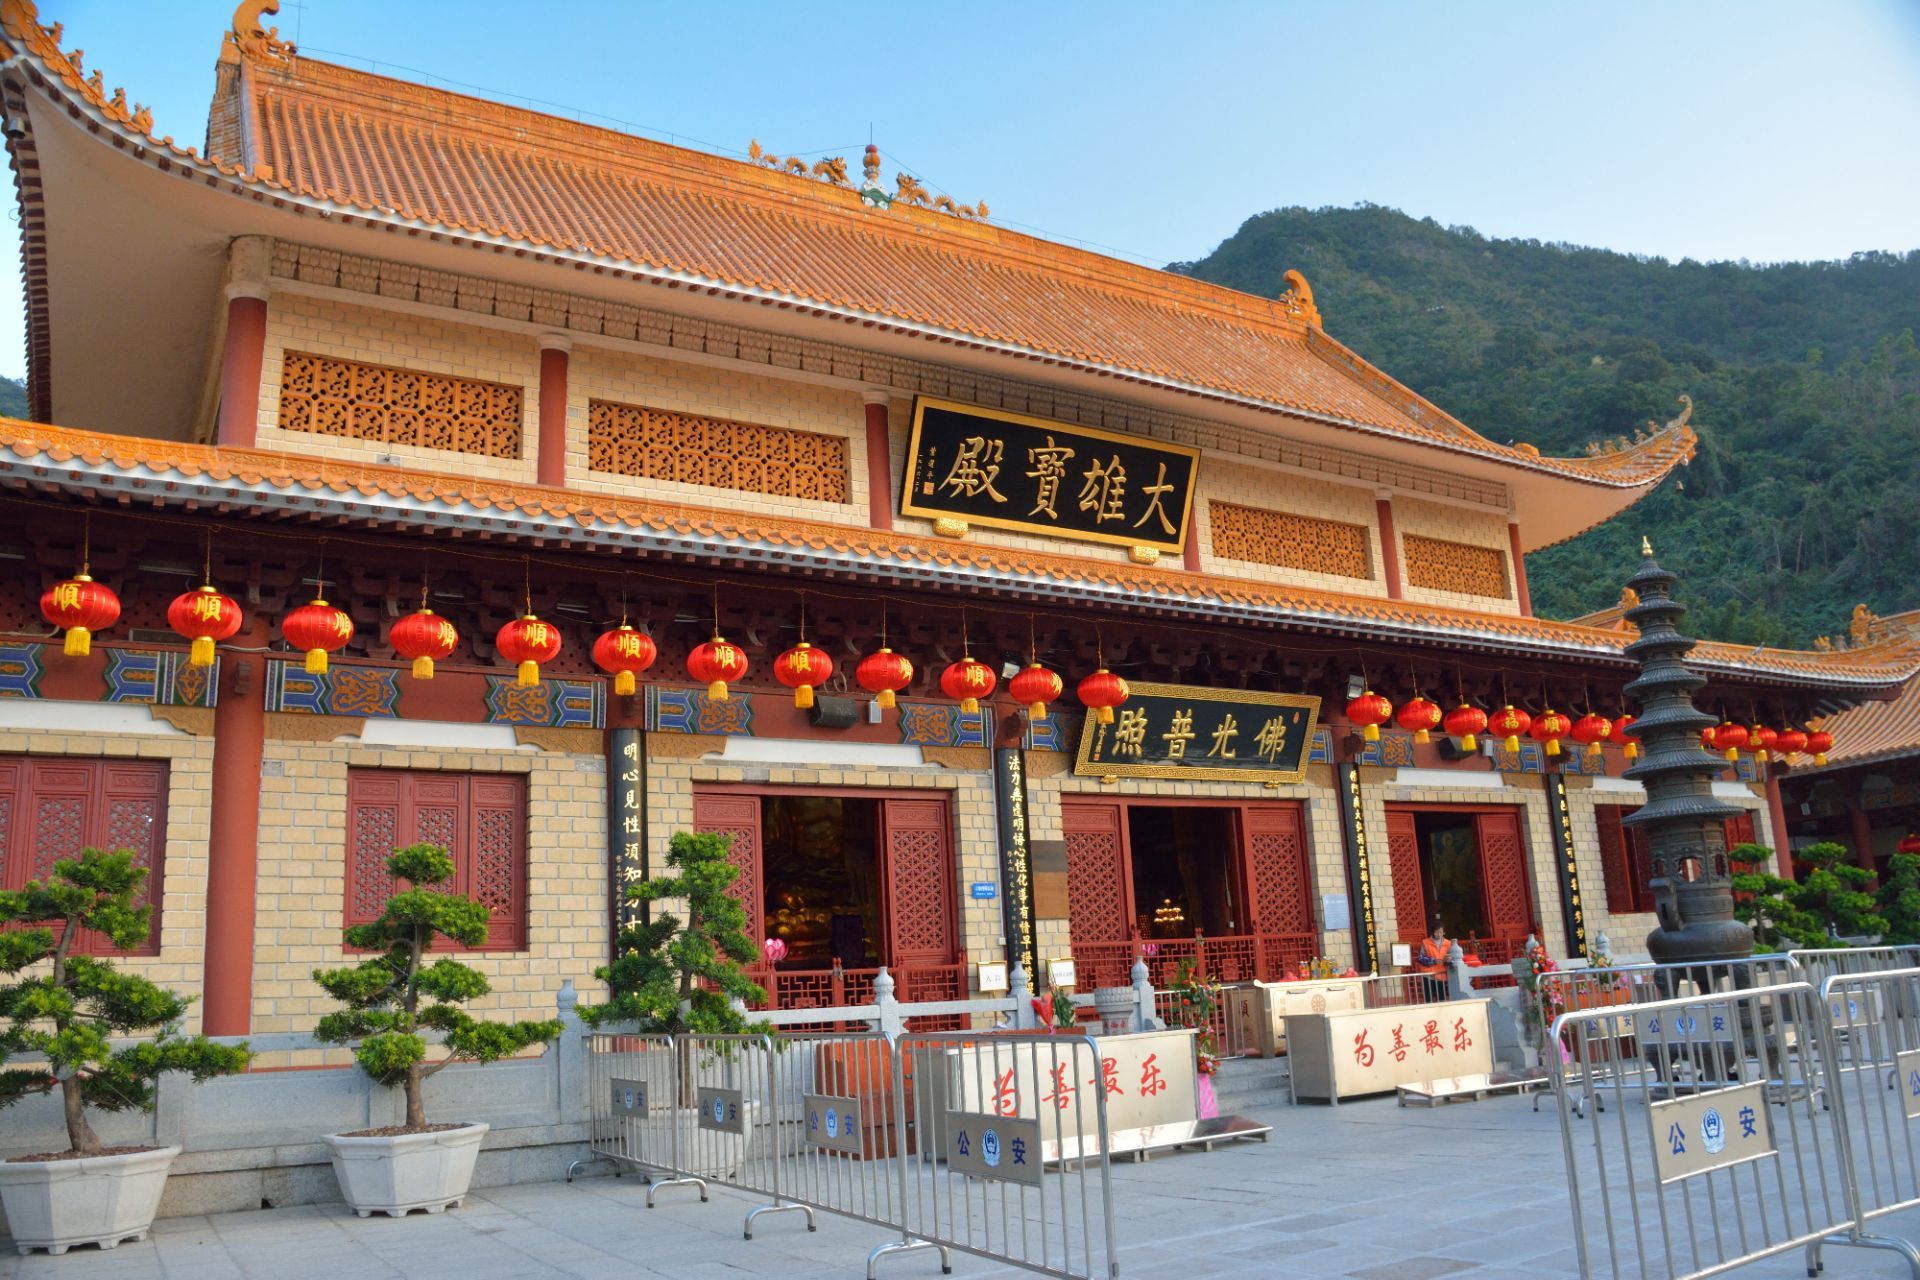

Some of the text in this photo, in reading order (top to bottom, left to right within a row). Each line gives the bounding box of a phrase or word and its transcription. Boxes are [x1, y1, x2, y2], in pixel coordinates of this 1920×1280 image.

[53, 583, 82, 611] 順
[195, 594, 222, 622] 順
[333, 611, 352, 639] 順
[438, 620, 457, 650] 順
[525, 622, 548, 648] 順
[618, 633, 641, 658] 順
[715, 645, 736, 669] 順
[789, 651, 812, 673] 順
[966, 665, 986, 687] 順
[1111, 706, 1287, 764] 佛光普照
[1544, 716, 1560, 733] 順
[622, 742, 642, 960] 明心見性須知方寸
[1648, 1016, 1724, 1033] 公安
[1353, 1017, 1473, 1068] 为善最乐
[991, 1053, 1166, 1117] 为善最乐
[702, 1102, 736, 1120] 公安
[810, 1110, 853, 1135] 公安
[1668, 1105, 1757, 1155] 公安
[957, 1129, 1026, 1165] 公安
